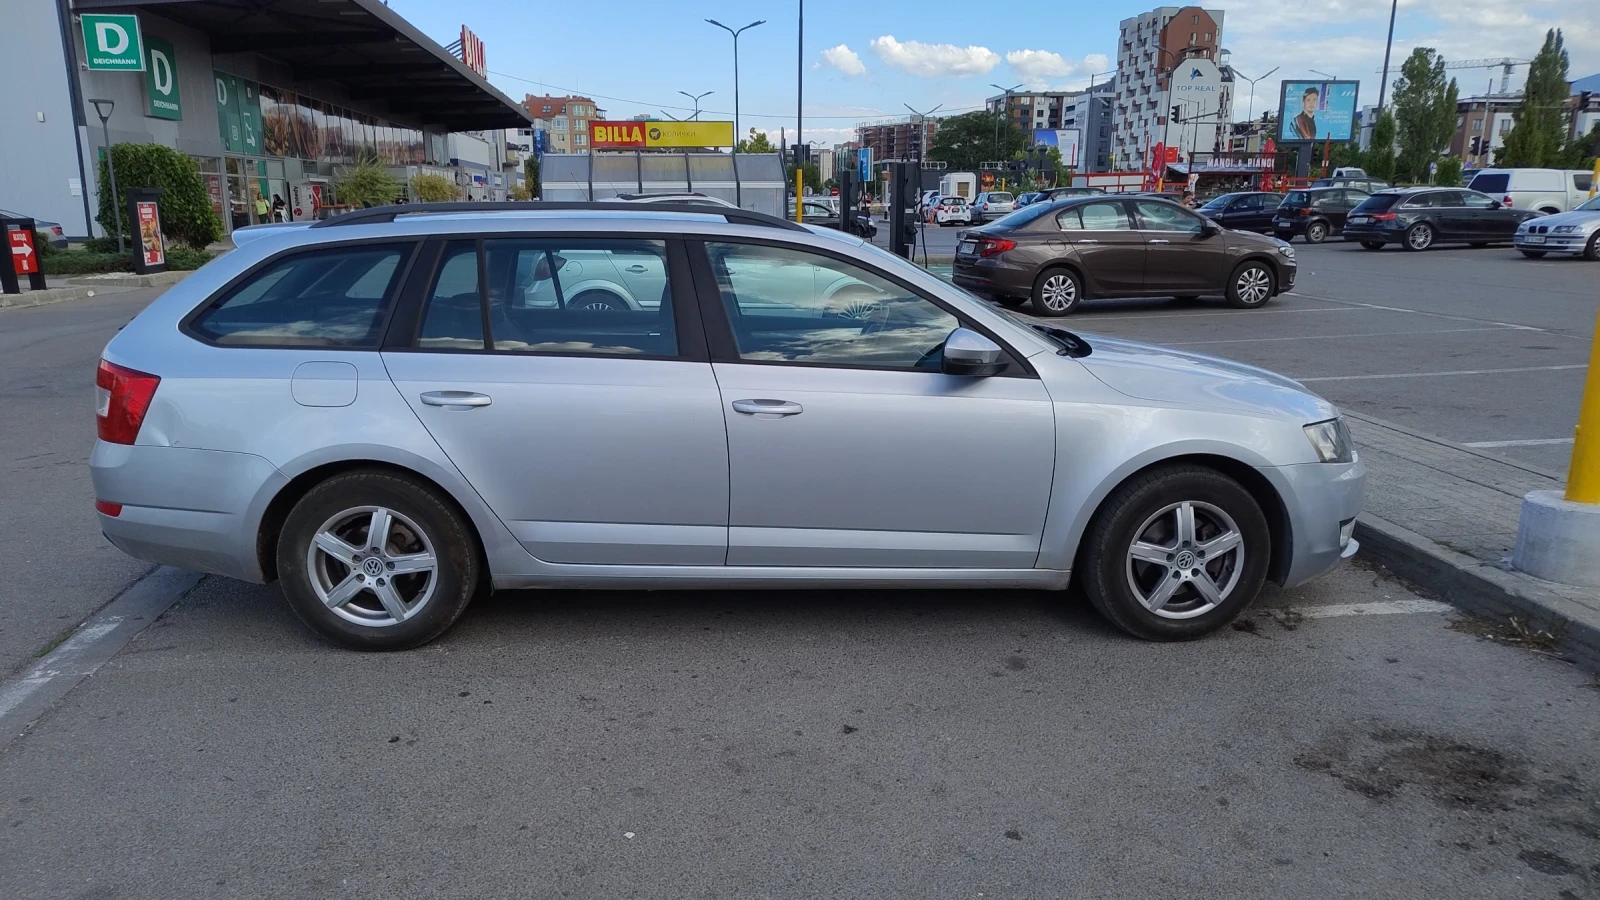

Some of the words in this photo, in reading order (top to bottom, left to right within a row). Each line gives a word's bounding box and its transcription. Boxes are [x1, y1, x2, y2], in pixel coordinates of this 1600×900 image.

[95, 22, 129, 55] D
[151, 49, 173, 96] D
[153, 99, 179, 111] DEICHMANN
[594, 126, 643, 143] BILLA
[1238, 158, 1243, 168] &
[293, 185, 301, 207] speedy
